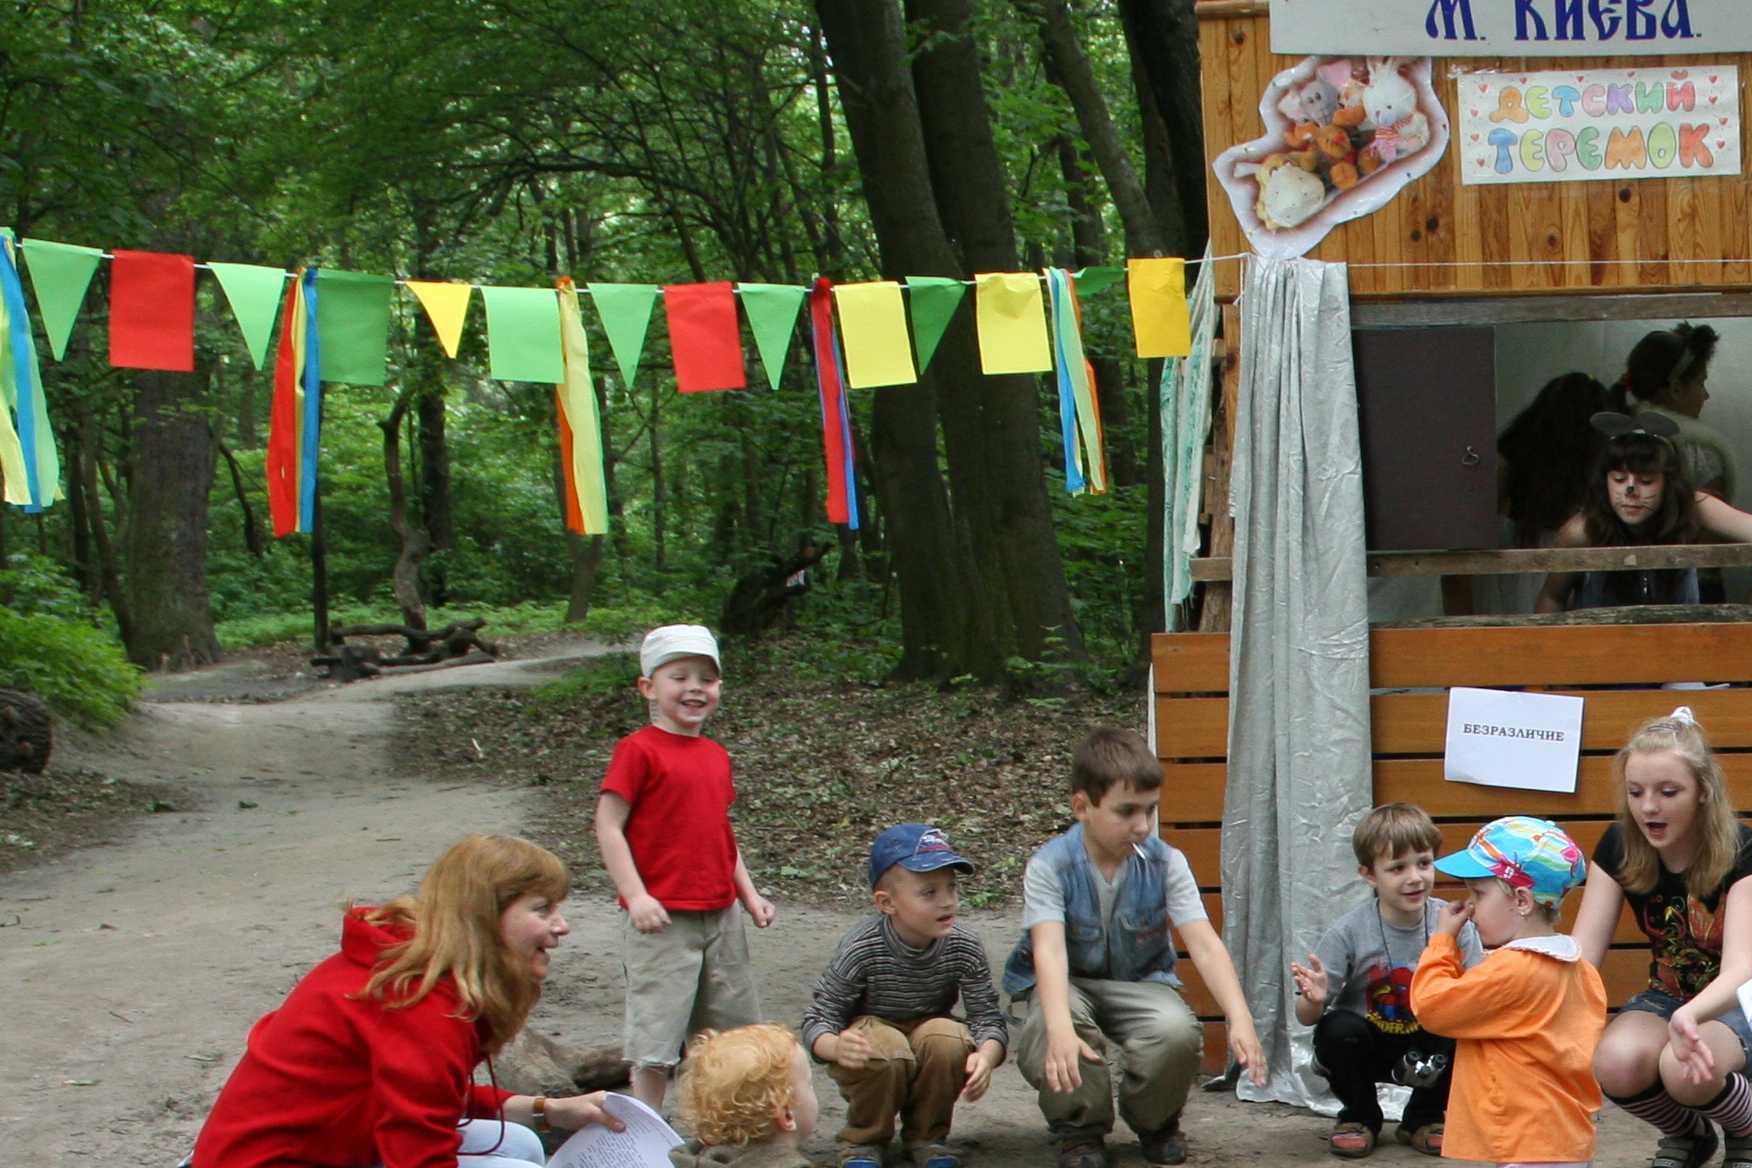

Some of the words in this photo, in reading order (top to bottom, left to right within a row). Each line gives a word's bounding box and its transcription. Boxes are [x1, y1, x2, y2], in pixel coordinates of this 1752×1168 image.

[1489, 69, 1697, 124] ДЕТСКИЙ
[1487, 121, 1714, 175] ТЕРЕМОК
[1462, 723, 1565, 742] БЕЗРАЗЛИЧИЕ
